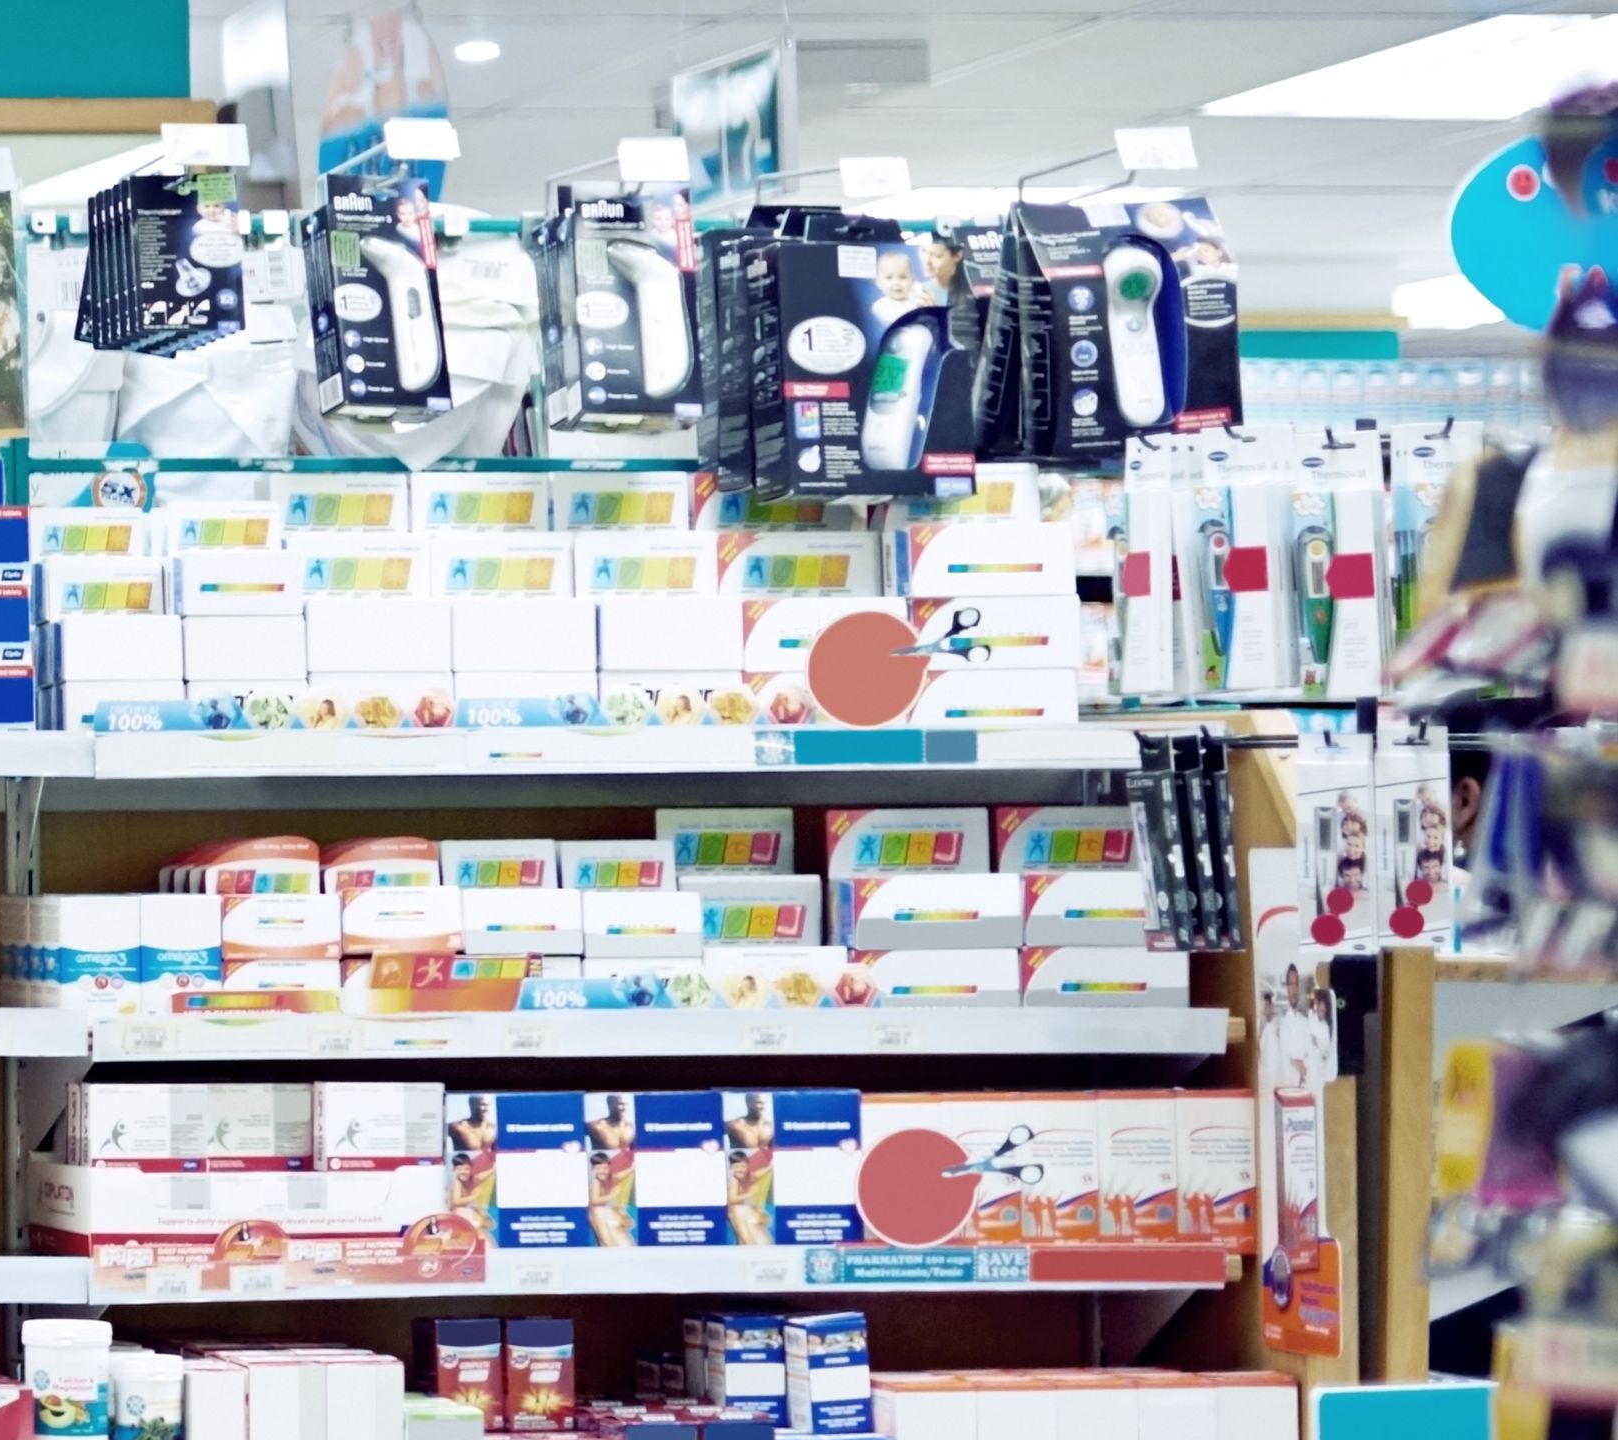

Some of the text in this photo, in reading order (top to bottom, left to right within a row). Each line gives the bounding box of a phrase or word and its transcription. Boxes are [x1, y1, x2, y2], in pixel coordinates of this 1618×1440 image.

[333, 194, 372, 212] BRAUN
[582, 201, 625, 219] BRAUN
[107, 714, 162, 731] 100%
[467, 710, 521, 725] 100%
[846, 1255, 924, 1265] PHARMATON
[977, 1252, 1026, 1265] SAVE
